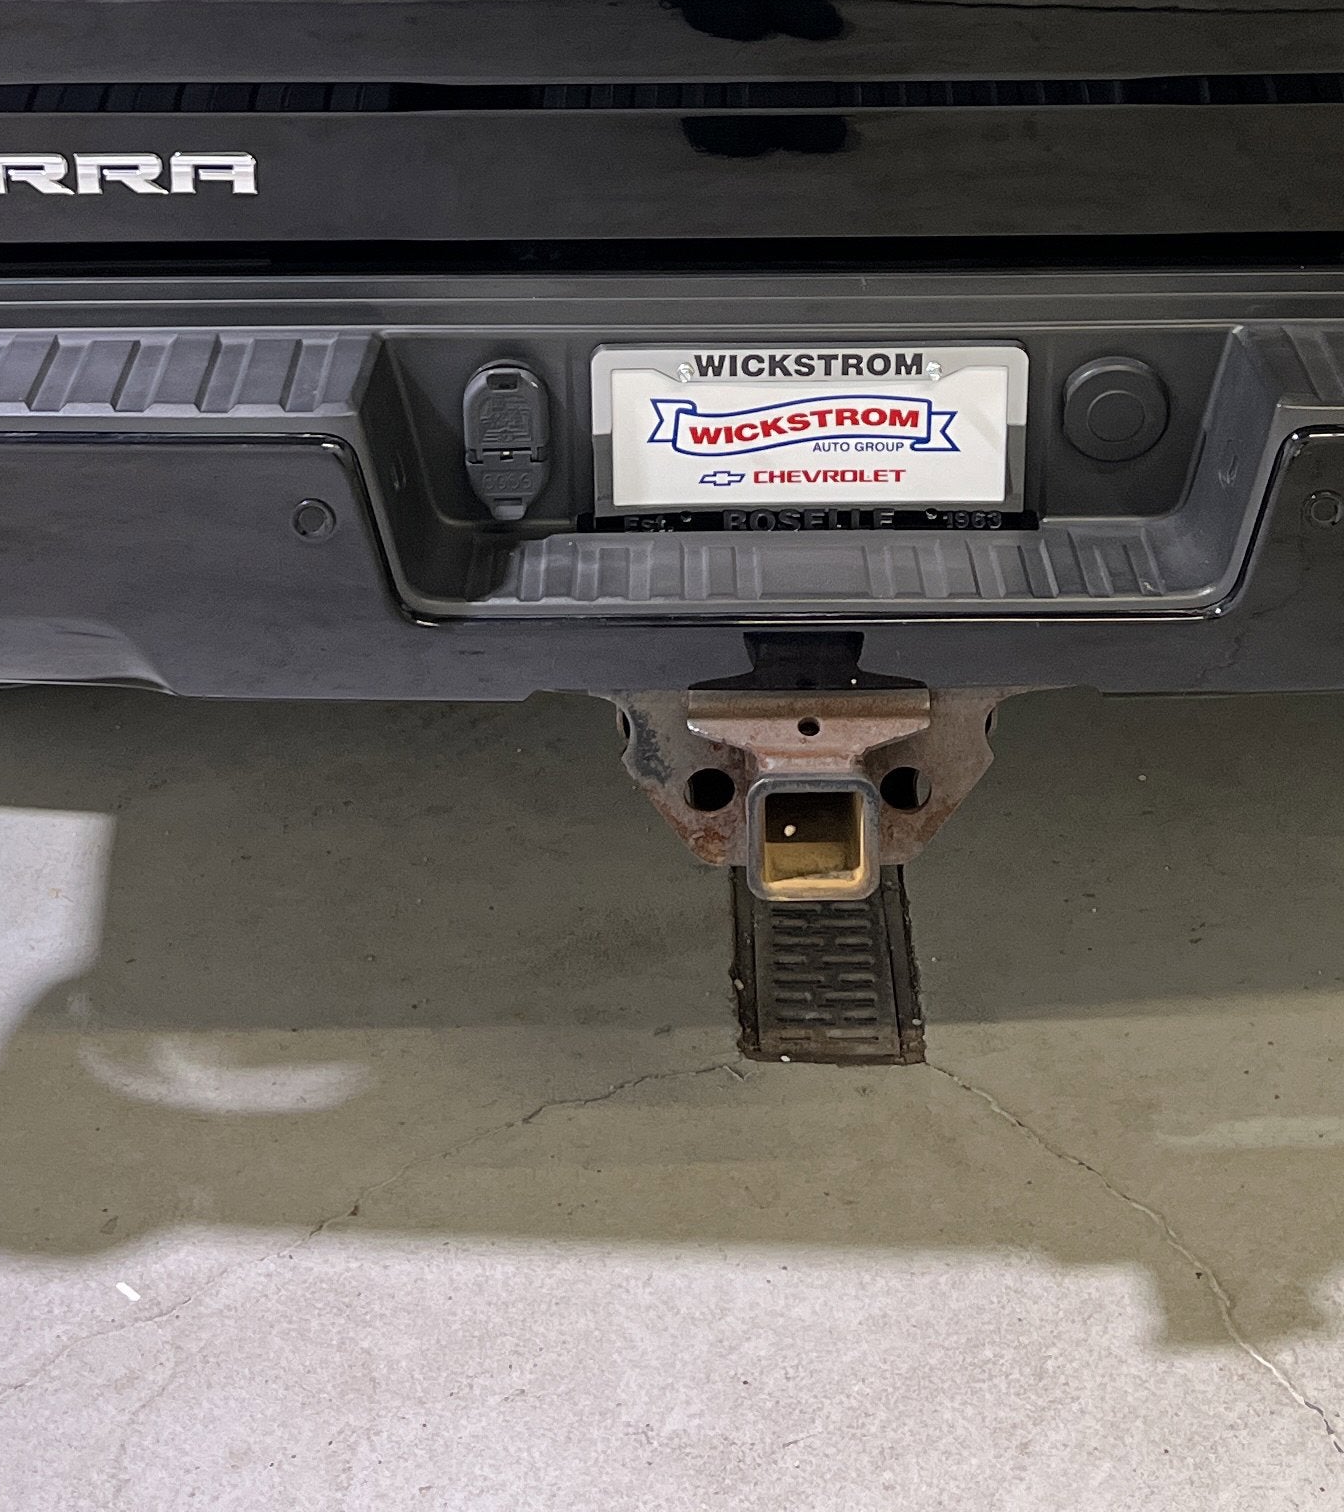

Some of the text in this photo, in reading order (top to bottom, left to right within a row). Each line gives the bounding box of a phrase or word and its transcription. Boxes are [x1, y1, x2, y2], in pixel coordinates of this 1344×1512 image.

[694, 353, 925, 379] WICKSTROM
[689, 407, 920, 445] WICKSTROM
[812, 441, 905, 454] AUTO GROUP
[753, 469, 907, 484] CHEVROLET
